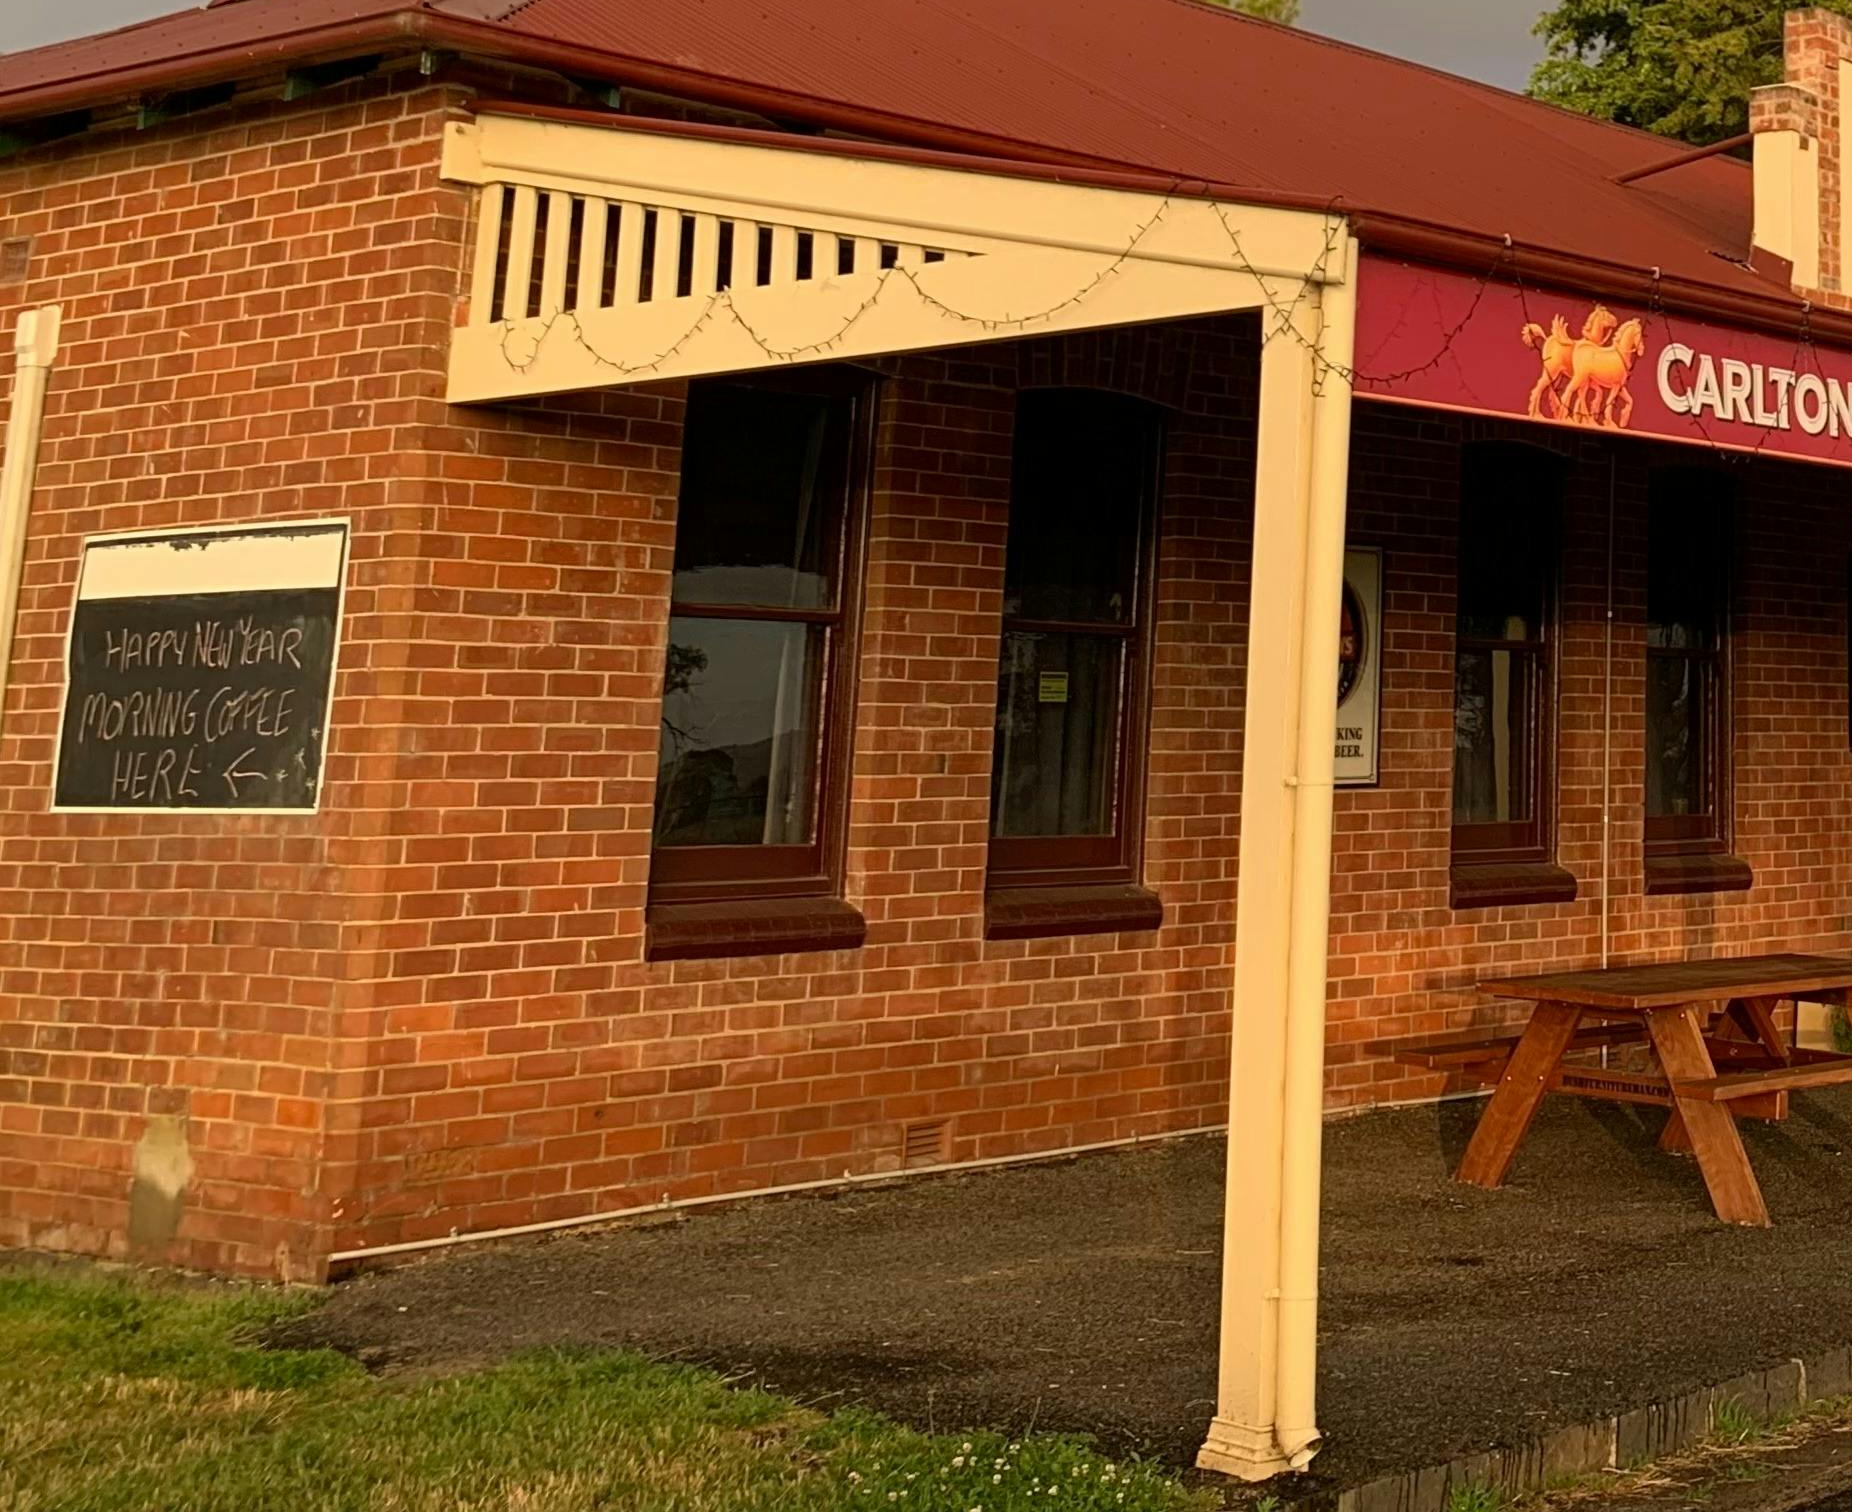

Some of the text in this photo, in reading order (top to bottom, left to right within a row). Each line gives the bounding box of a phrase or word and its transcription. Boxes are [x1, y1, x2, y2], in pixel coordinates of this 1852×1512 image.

[106, 615, 303, 673] HAPPY NEW YEAR
[78, 686, 296, 744] MORNING COFFEE
[111, 744, 201, 800] HERE
